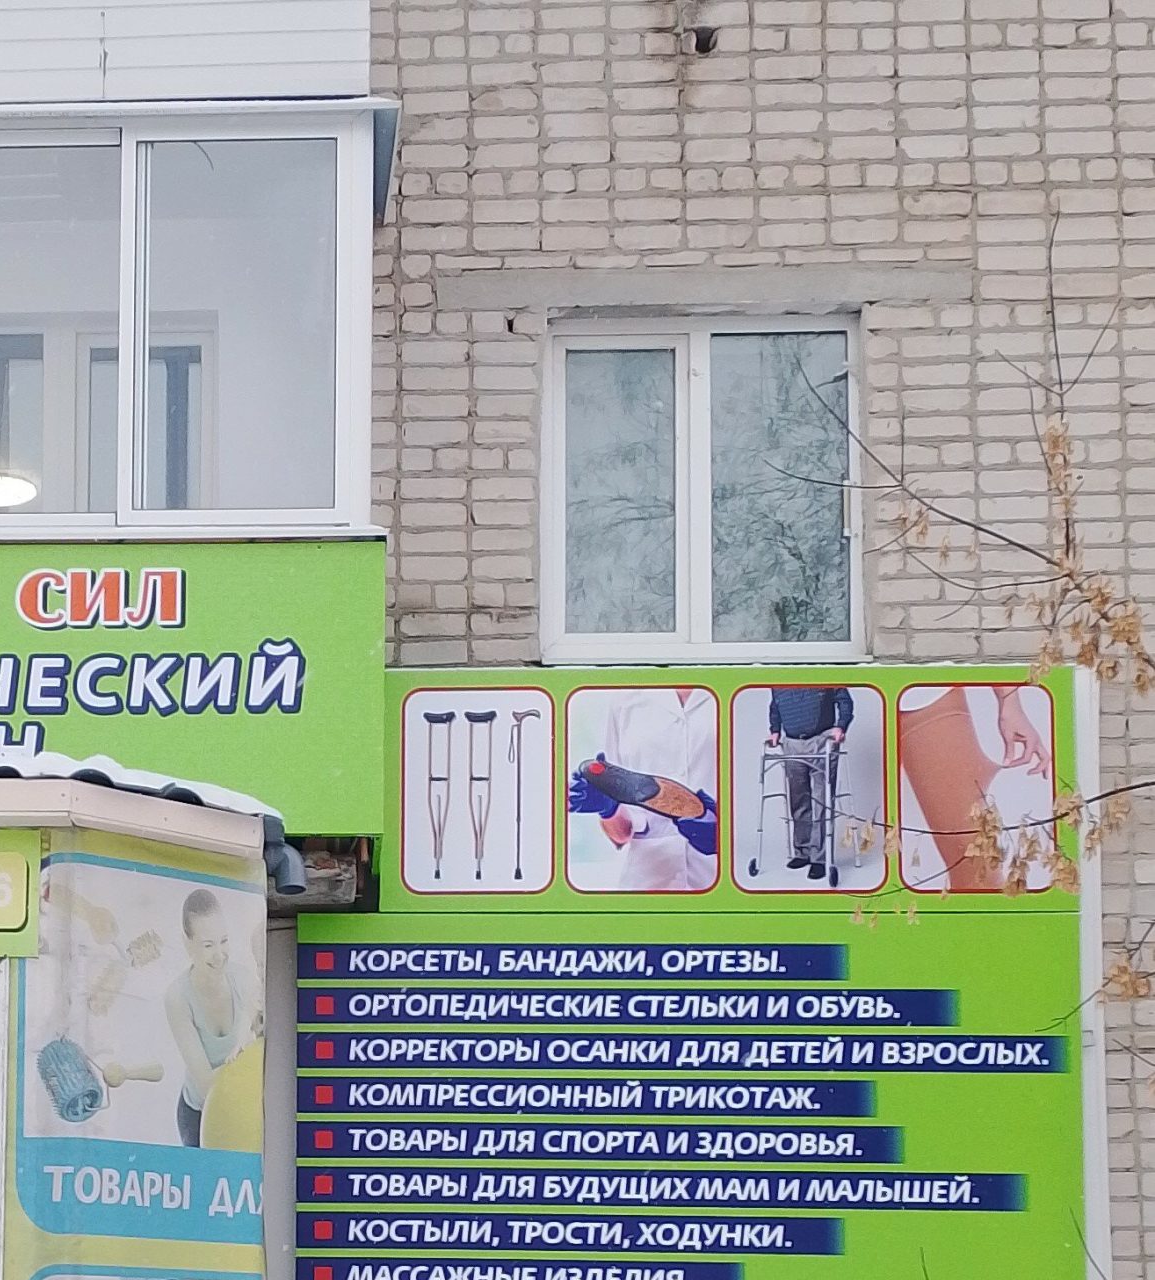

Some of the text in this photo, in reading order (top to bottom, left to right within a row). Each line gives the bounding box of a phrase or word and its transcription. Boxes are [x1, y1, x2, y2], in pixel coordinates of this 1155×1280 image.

[14, 567, 187, 630] СИЛ
[348, 949, 787, 977] КОРСЕТЫ, БАНДАЖИ, ОРТЕЗЫ.
[348, 994, 901, 1021] ОРТОПЕДИЧЕСКИЕ СТЕЛЬКИ И ОБУВЬ.
[348, 1036, 1049, 1067] КОРРЕКТОРЫ ОСАНКИ ДЛЯ ДЕТЕЙ И ВЗРОСЛЫХ.
[348, 1080, 821, 1110] КОМПРЕССИОННЫЙ ТРИКОТАЖ.
[348, 1129, 864, 1158] ТОВАРЫ ДЛЯ СПОРТА И ЗДОРОВЬЯ.
[43, 1165, 263, 1218] ТОВАРЫ ДЛ
[348, 1174, 980, 1204] ТОВАРЫ ДЛЯ БУДУЩИХ МАМ И МАЛЫШЕЙ.
[348, 1219, 793, 1251] КОСТЫЛИ, ТРОСТИ, ХОДУНКИ.
